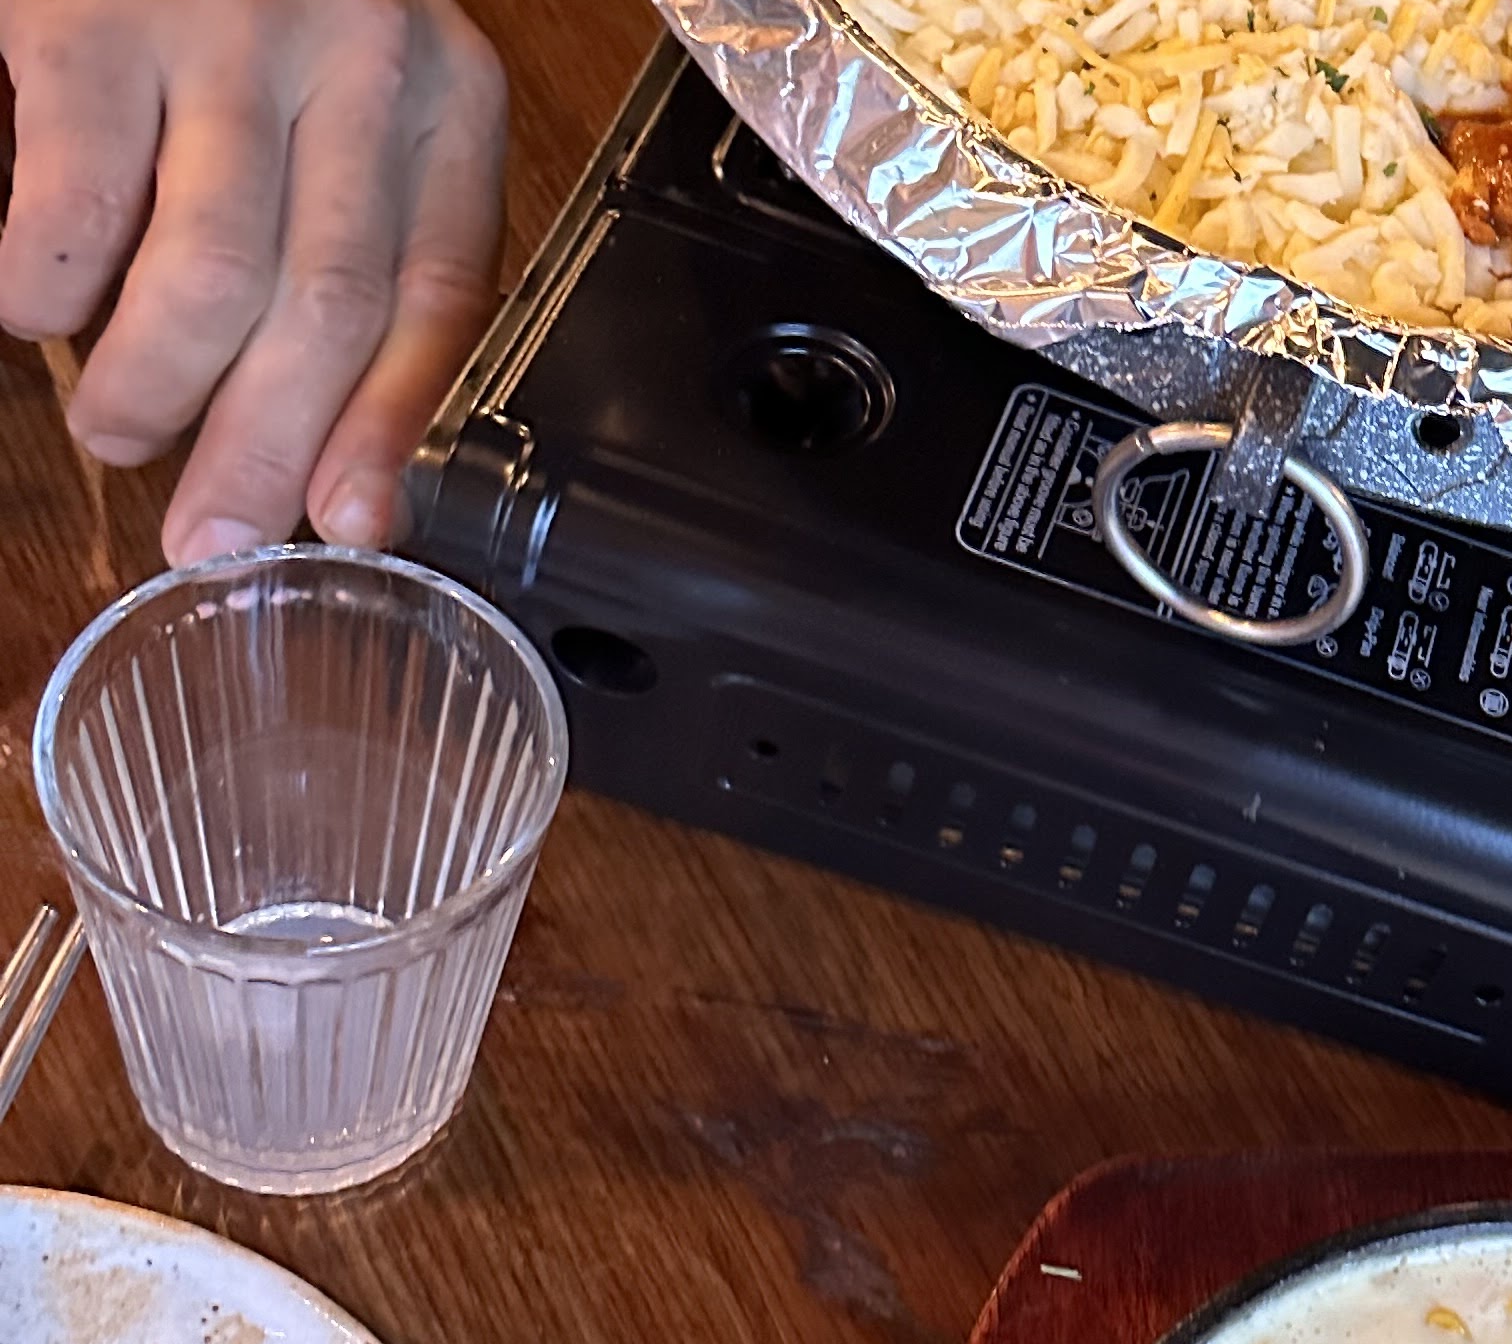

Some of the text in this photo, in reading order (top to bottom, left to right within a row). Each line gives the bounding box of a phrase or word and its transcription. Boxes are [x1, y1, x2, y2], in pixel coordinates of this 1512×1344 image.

[1019, 464, 1041, 486] the
[1005, 482, 1031, 519] above
[992, 516, 1020, 553] figure
[1013, 535, 1035, 554] be
